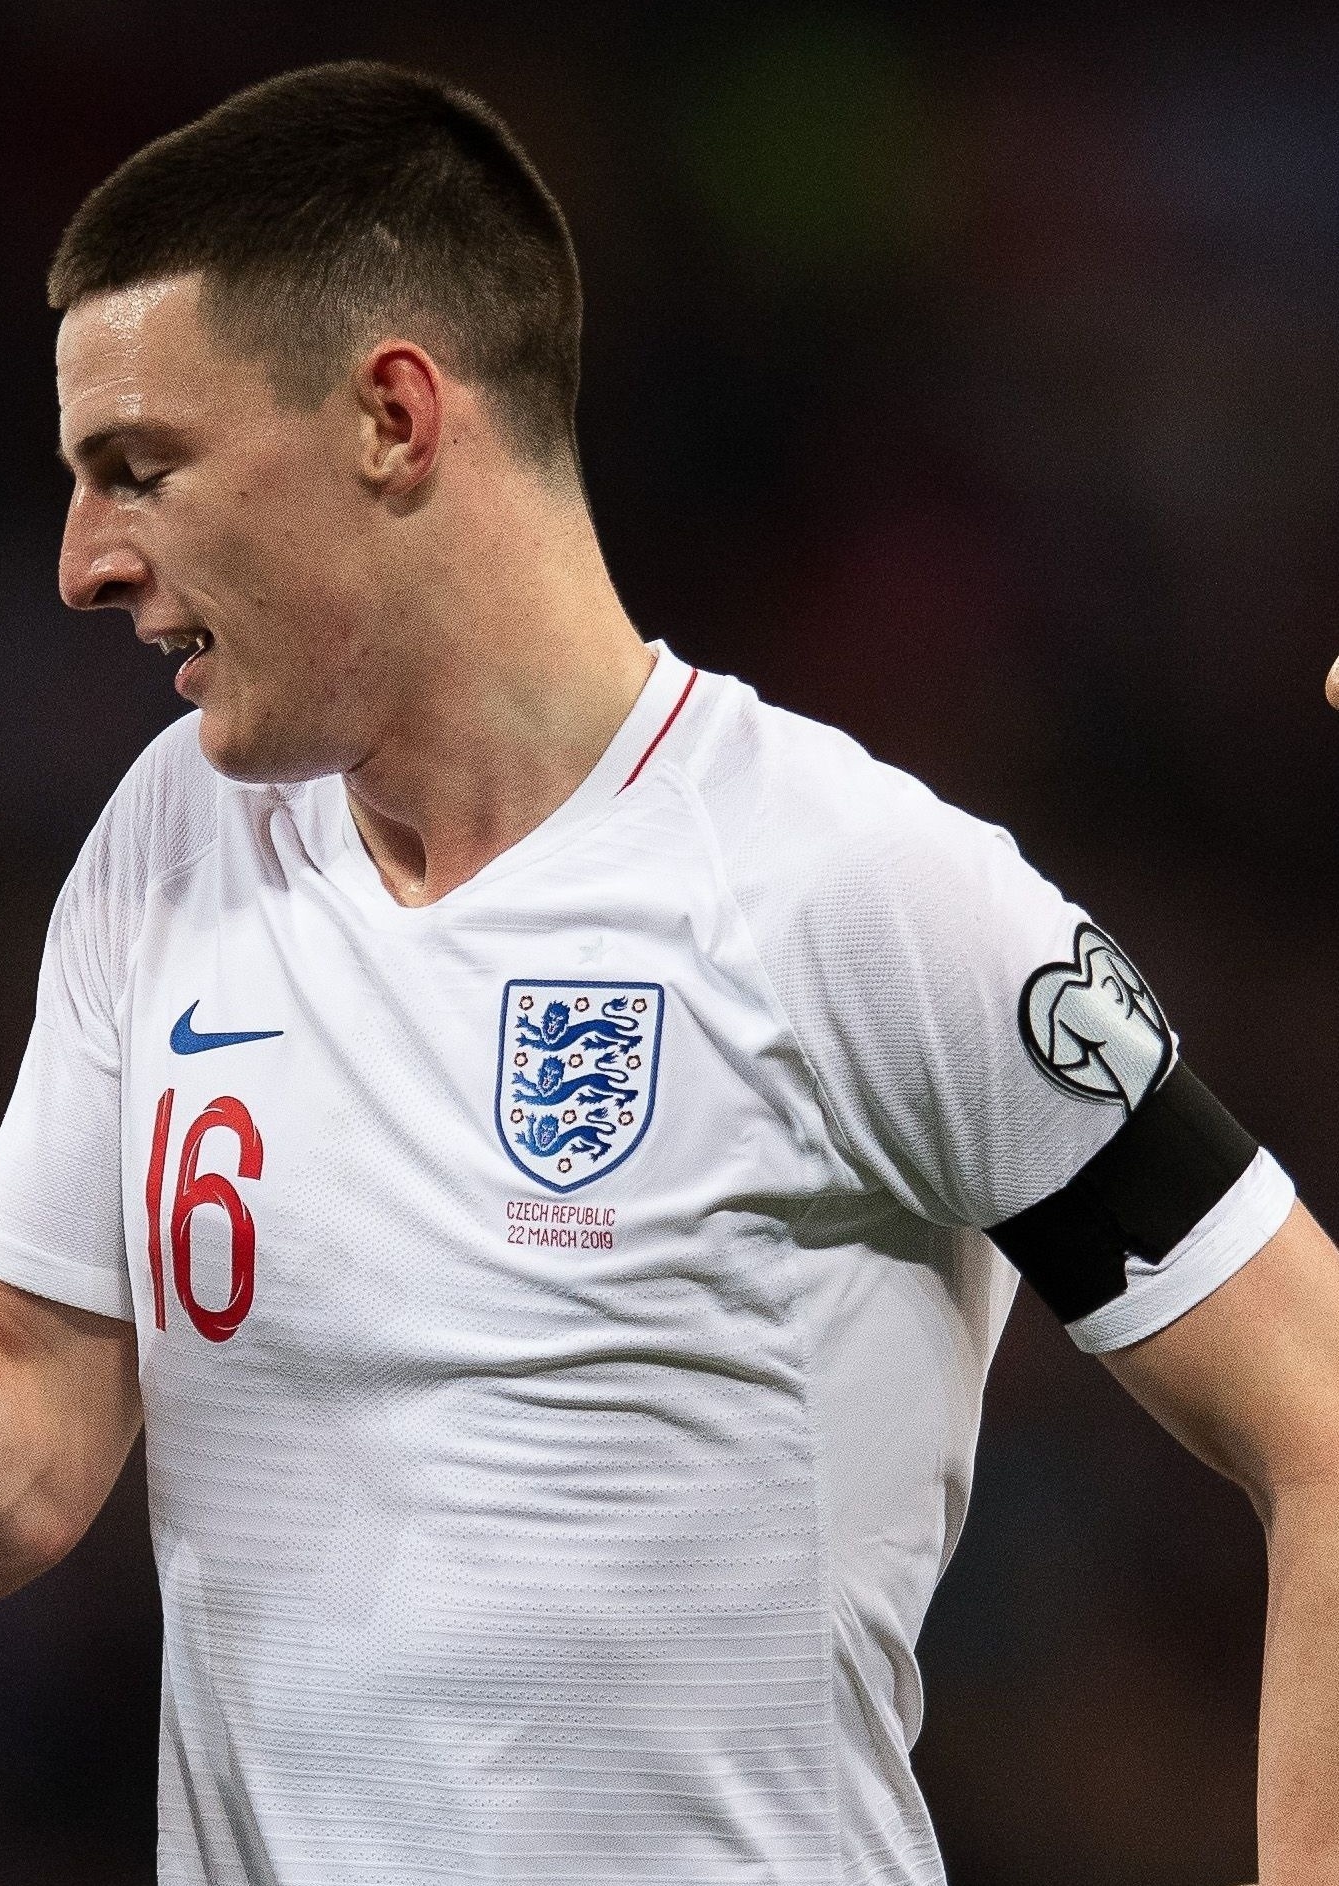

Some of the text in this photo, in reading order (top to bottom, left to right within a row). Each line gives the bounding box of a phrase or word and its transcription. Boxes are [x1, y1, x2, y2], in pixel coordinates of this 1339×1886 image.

[145, 1088, 264, 1343] 16
[506, 1201, 616, 1227] CZECH REPUBLIC
[507, 1224, 613, 1249] 22 MARCH 2019
